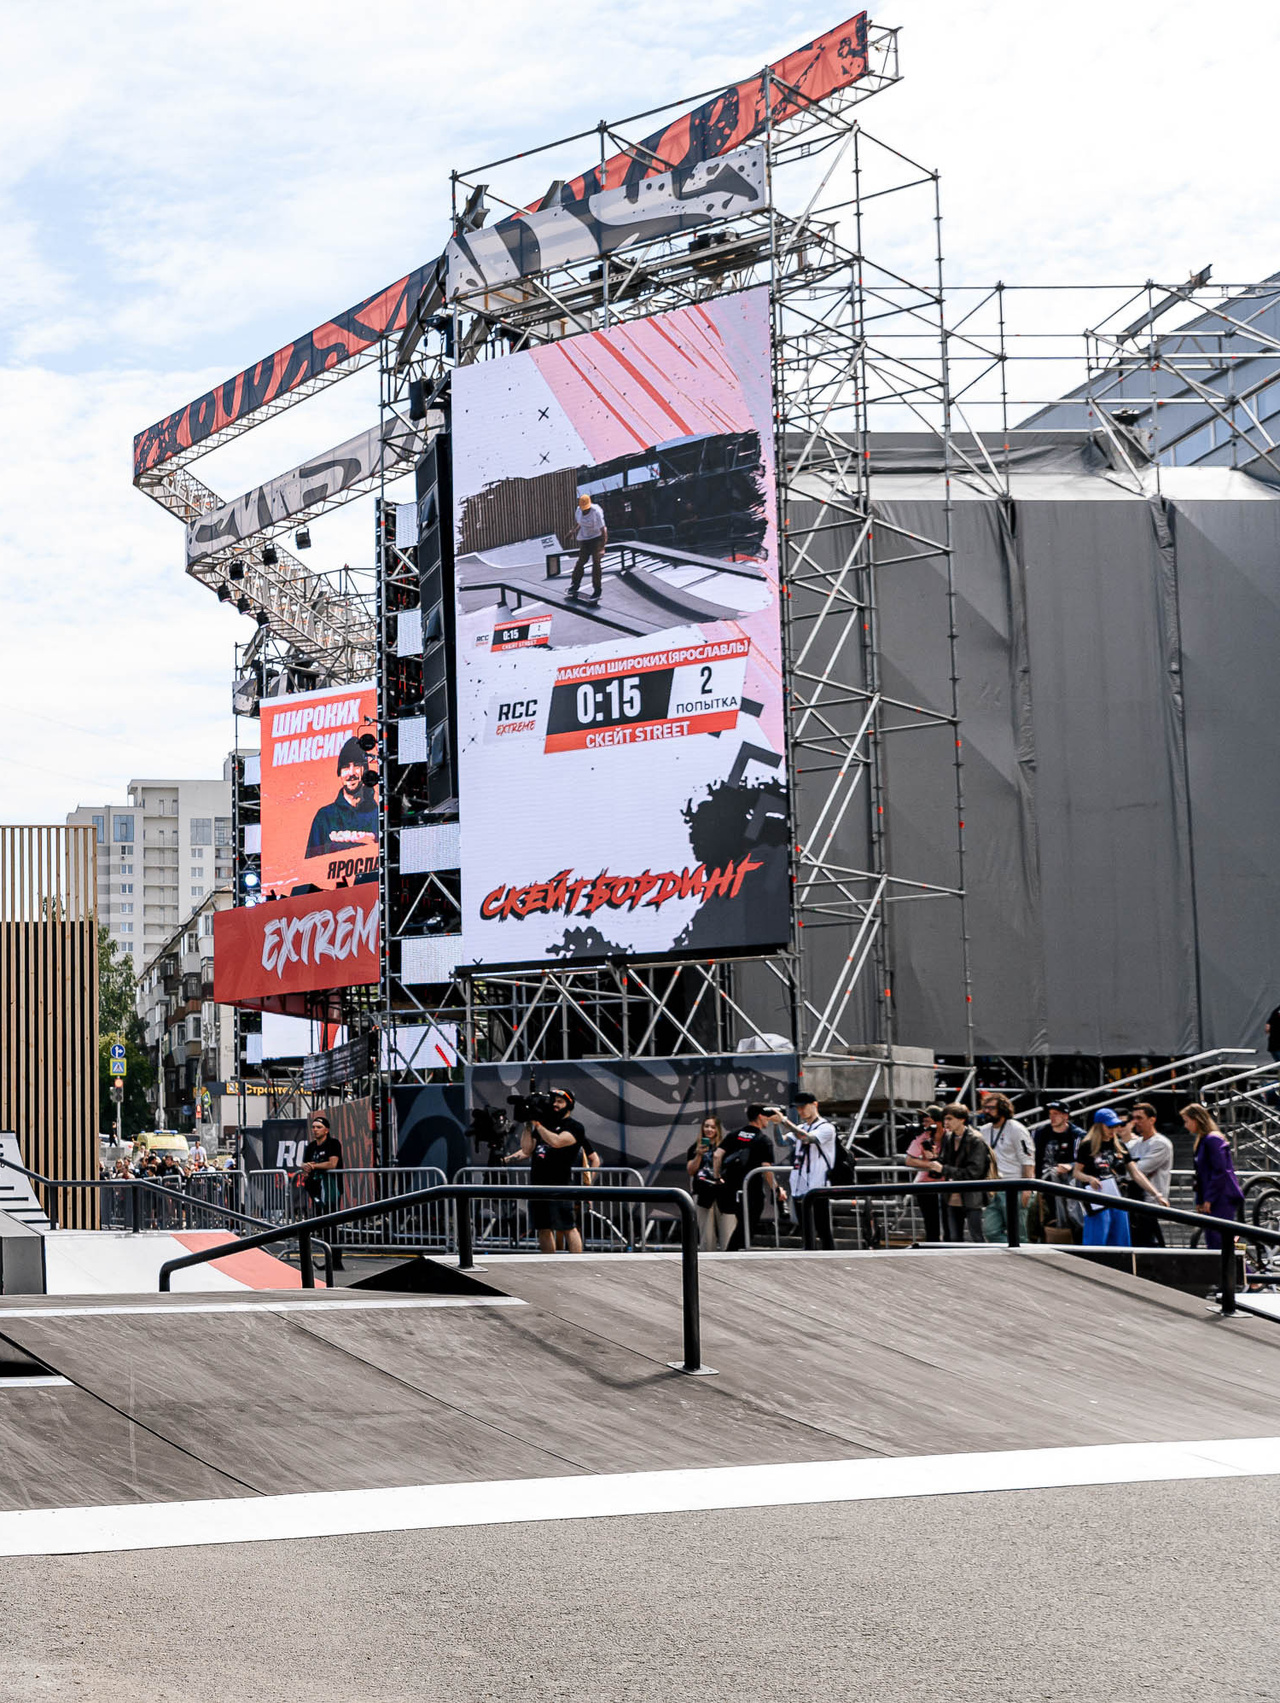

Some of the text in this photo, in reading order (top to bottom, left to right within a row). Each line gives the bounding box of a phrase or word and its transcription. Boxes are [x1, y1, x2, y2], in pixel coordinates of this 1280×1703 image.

[502, 628, 519, 641] 0:15
[556, 664, 605, 682] МАКСИМ
[607, 654, 667, 674] ШИРОКИХ
[700, 665, 713, 695] 2
[498, 699, 537, 722] RCC
[576, 676, 642, 725] 0:15
[676, 696, 738, 715] ПОПЫТКА
[271, 698, 361, 738] ШИРОКИХ
[495, 720, 536, 737] EXTREME
[586, 721, 690, 748] СКЕЙТ STREET
[480, 853, 764, 922] СКЕЙТБОРДИНГ
[261, 899, 379, 980] EXTREM
